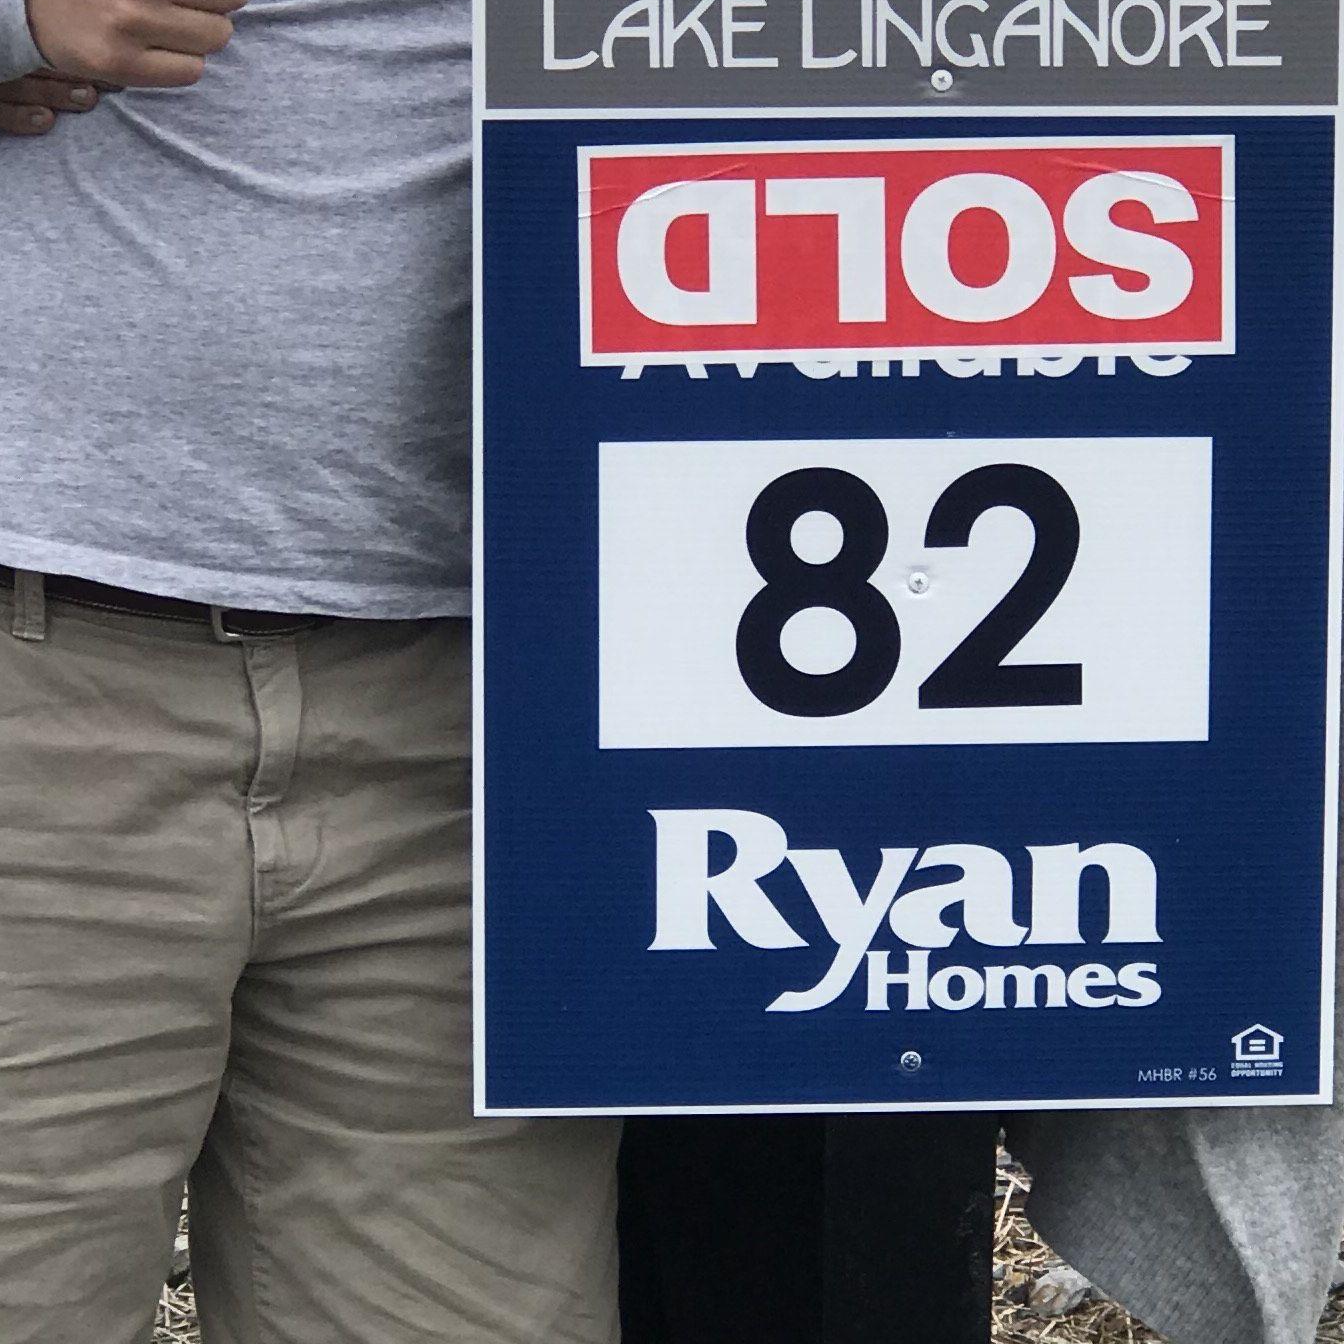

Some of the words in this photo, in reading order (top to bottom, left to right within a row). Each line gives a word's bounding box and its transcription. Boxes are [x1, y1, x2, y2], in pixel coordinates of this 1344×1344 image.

[616, 169, 1200, 327] SOLD
[735, 462, 1084, 719] 82
[646, 808, 1165, 1013] Ryan
[864, 949, 1163, 1012] Homes
[1137, 1068, 1183, 1083] MHBR
[1188, 1067, 1218, 1082] #56
